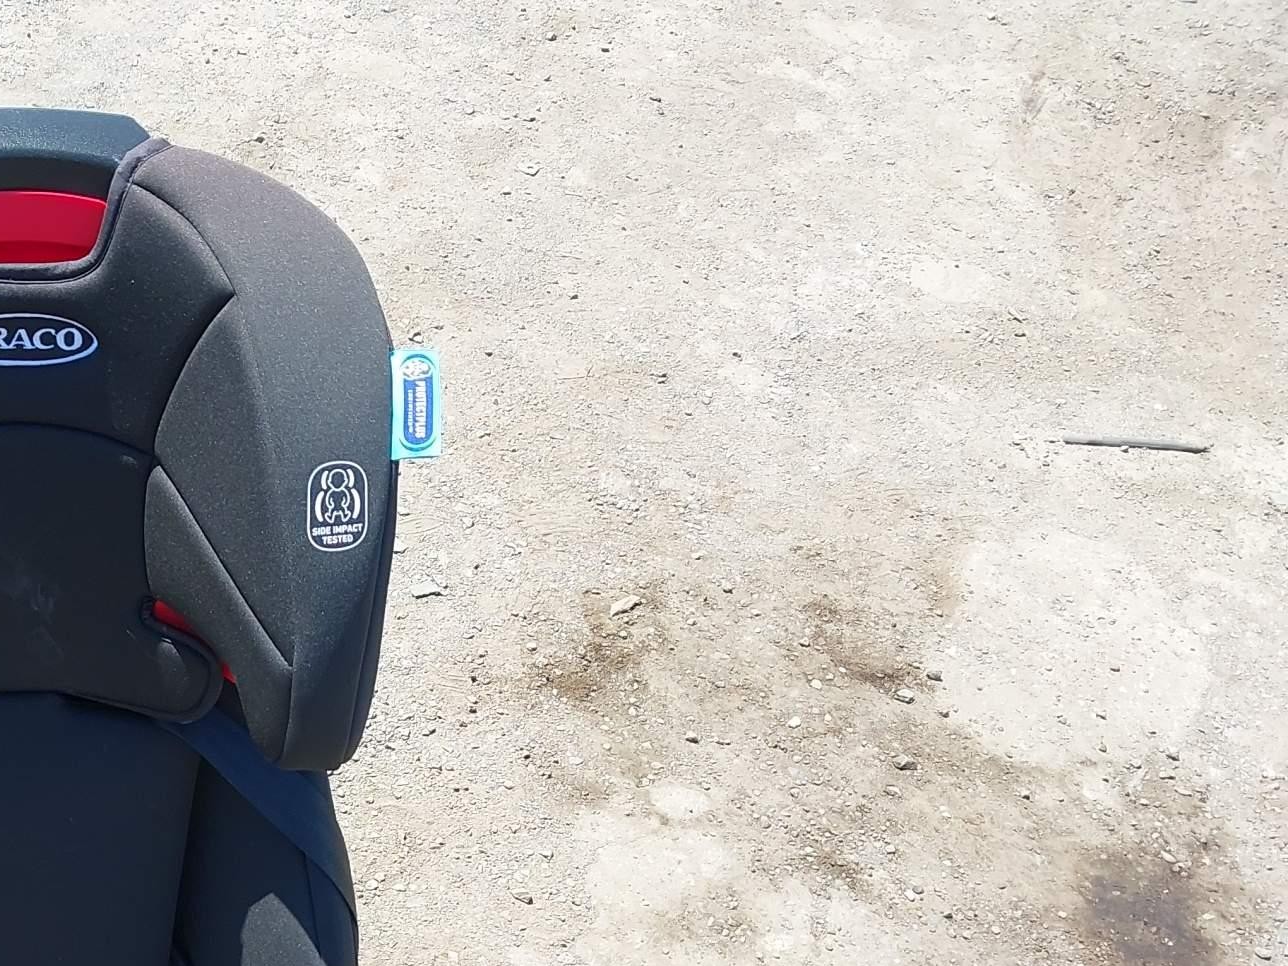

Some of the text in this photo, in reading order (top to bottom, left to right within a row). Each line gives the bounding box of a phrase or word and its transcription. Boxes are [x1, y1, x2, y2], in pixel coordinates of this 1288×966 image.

[312, 523, 363, 536] SIDE IMPACT
[322, 535, 353, 545] TESTED
